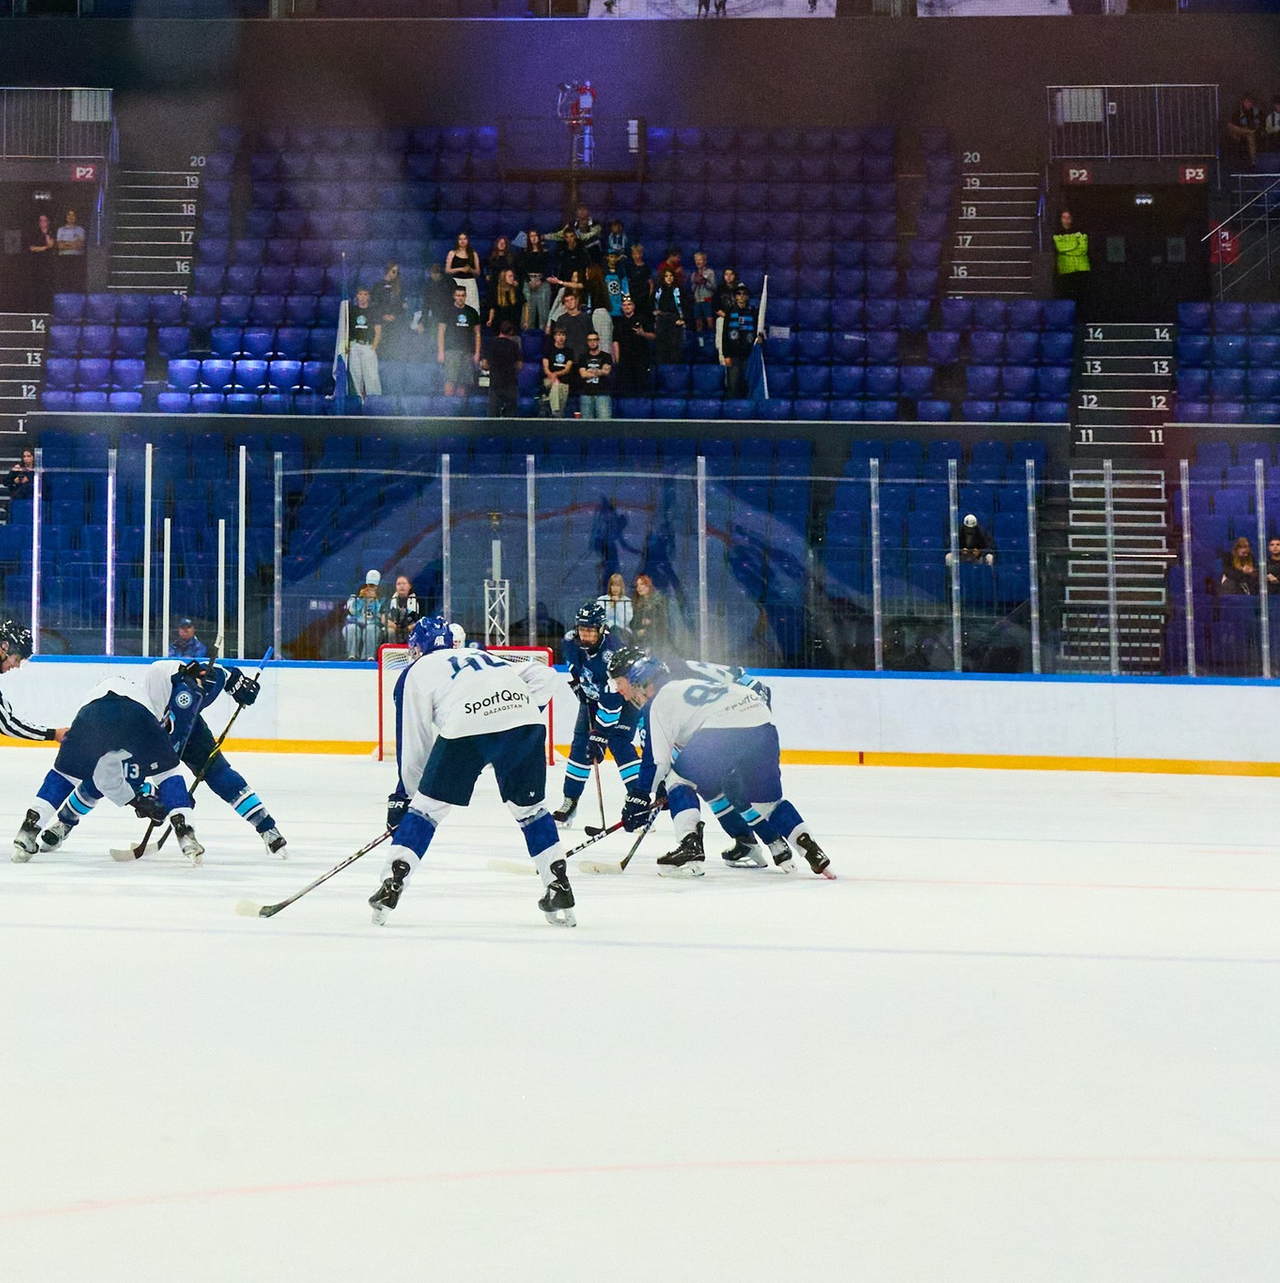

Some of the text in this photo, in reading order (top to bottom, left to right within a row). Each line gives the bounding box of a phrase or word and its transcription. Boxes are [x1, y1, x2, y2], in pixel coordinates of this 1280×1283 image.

[190, 156, 206, 166] 20
[963, 152, 980, 163] 20
[76, 167, 94, 179] P2
[1069, 168, 1205, 181] P2 P3
[185, 176, 199, 187] 19
[966, 178, 980, 189] 19
[182, 204, 196, 215] 18
[962, 206, 977, 218] 18
[180, 231, 194, 242] 17
[958, 235, 972, 247] 17
[175, 261, 190, 273] 16
[953, 266, 968, 277] 16
[31, 319, 45, 331] 14
[1088, 328, 1170, 340] 14 14
[27, 352, 41, 365] 13
[1085, 361, 1169, 373] 13 13
[22, 384, 36, 397] 12
[1082, 395, 1167, 408] 12 12
[1080, 429, 1163, 442] 11 11
[572, 830, 607, 854] CCM
